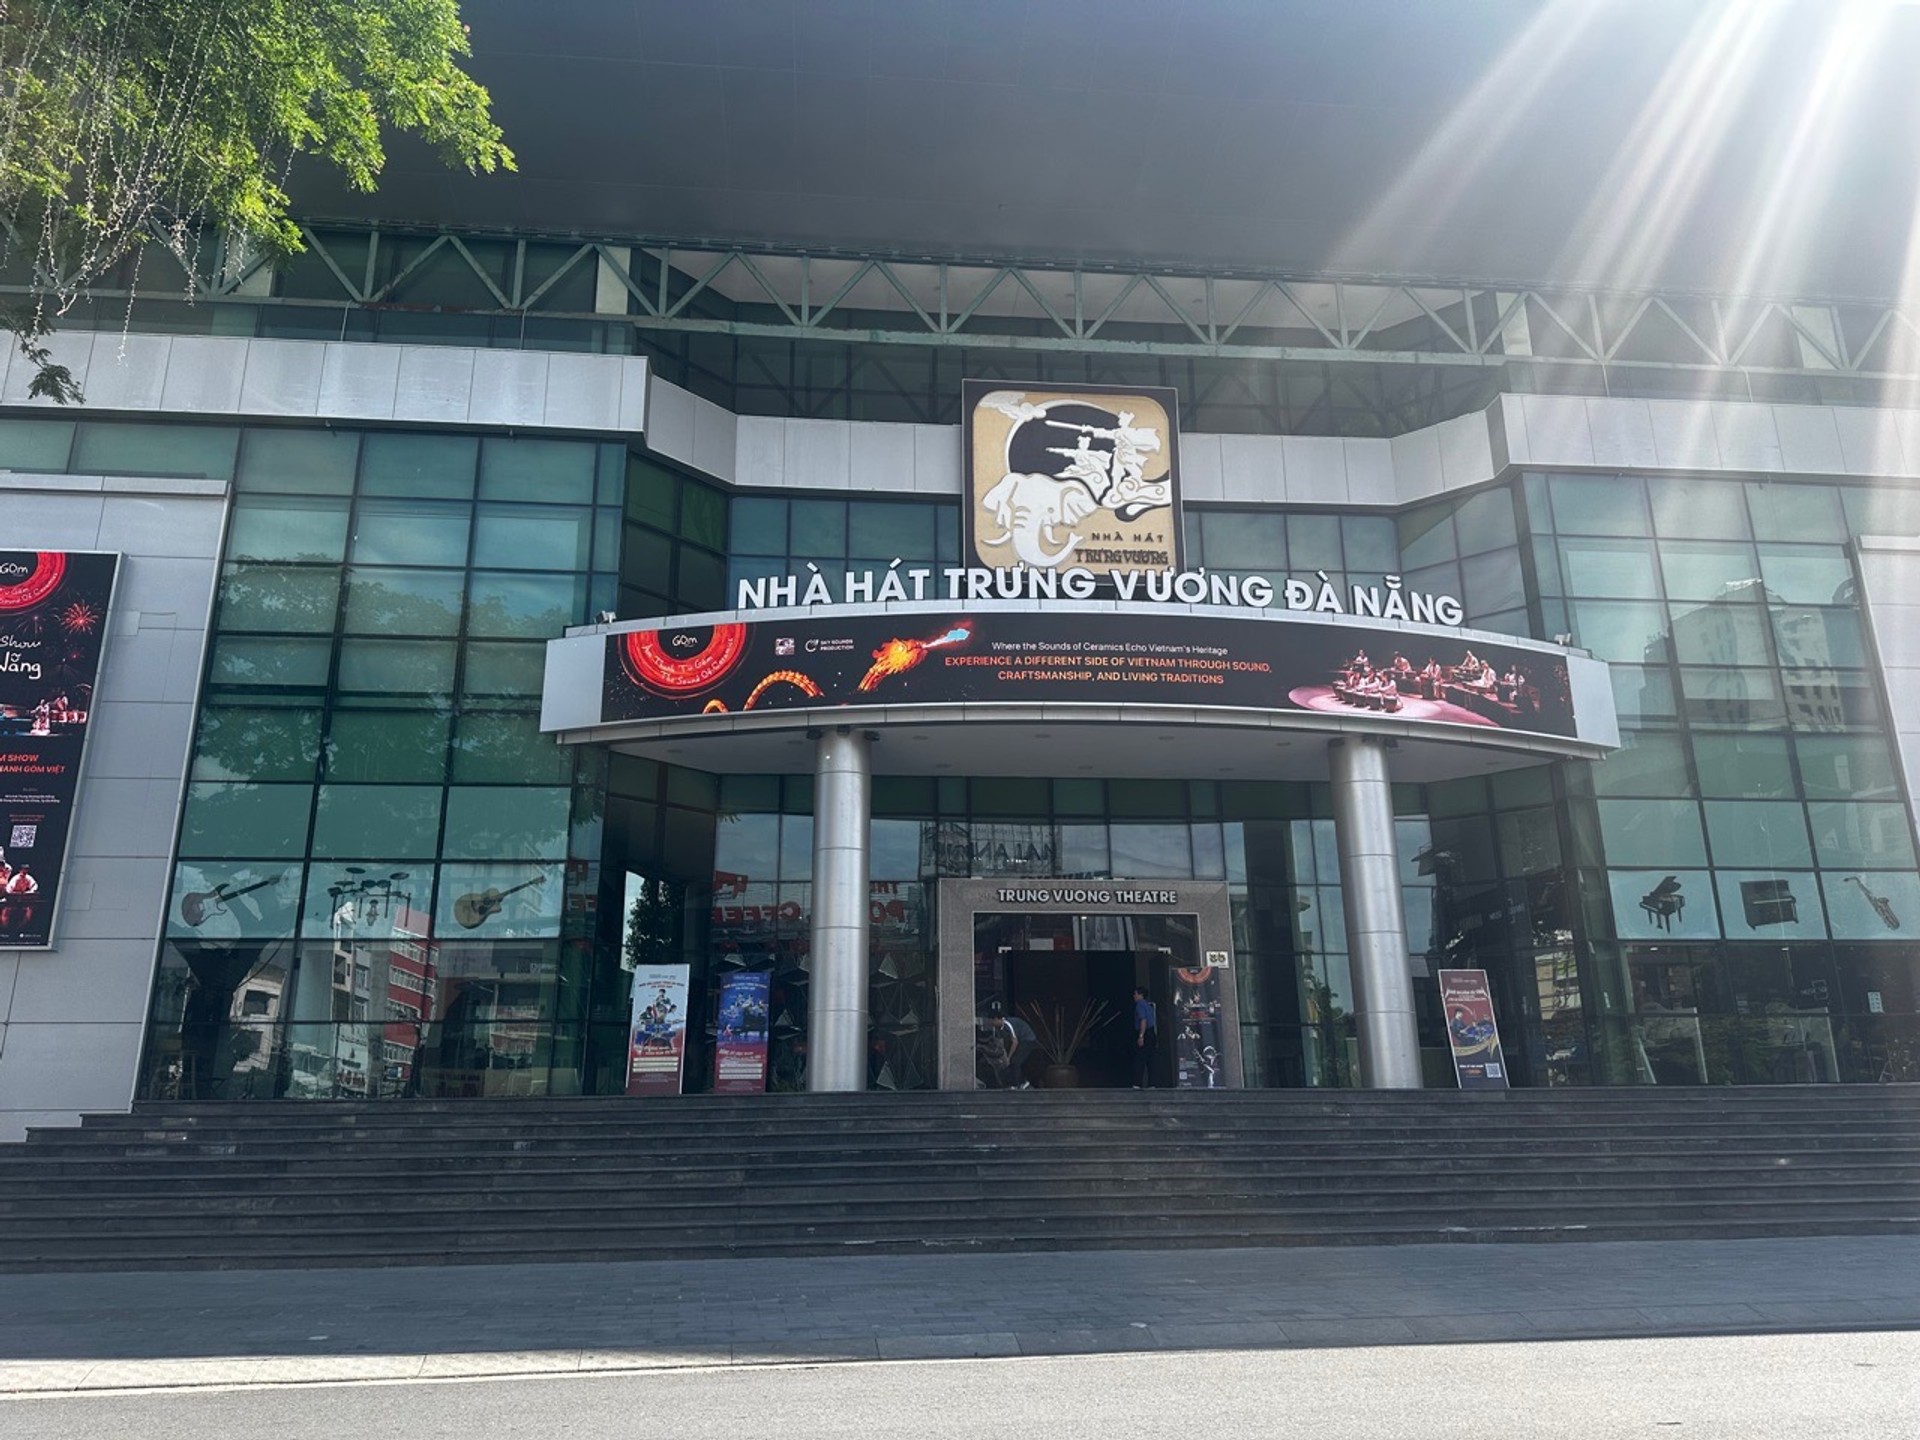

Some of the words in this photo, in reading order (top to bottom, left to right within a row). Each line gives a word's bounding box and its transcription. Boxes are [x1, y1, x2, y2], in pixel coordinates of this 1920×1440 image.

[1092, 531, 1123, 541] NHÀ
[1133, 532, 1164, 543] HÁT
[738, 561, 833, 609] NHÀ
[845, 557, 931, 603] HÁT
[944, 561, 1097, 600] TRƯNG
[1108, 566, 1273, 608] VƯƠNG
[1284, 570, 1344, 614] ĐÀ
[1352, 575, 1464, 626] NẴNG
[991, 641, 1021, 651] Where
[1022, 641, 1036, 651] the
[1037, 641, 1071, 651] Sounds
[1072, 641, 1082, 651] of
[1082, 642, 1124, 652] Ceramics
[1125, 643, 1147, 652] Echo
[1192, 645, 1228, 657] Heritage
[944, 656, 1012, 666] EXPERIENCE
[1013, 656, 1023, 666] A
[1024, 656, 1082, 666] DIFFERENT
[1084, 657, 1108, 666] SIDE
[1110, 657, 1126, 666] OF
[1127, 657, 1176, 668] VIETNAM
[1177, 658, 1231, 670] THROUGH
[1232, 661, 1272, 673] SOUND,
[997, 670, 1095, 682] CRAFTSMANSHIP,
[1096, 671, 1120, 681] AND
[1122, 672, 1158, 682] LIVING
[1160, 673, 1225, 685] TRADITIONS
[7, 754, 39, 762] SHOW
[997, 888, 1050, 903] TRUNG
[1052, 888, 1111, 904] VUONG
[1115, 890, 1177, 904] THEATRE
